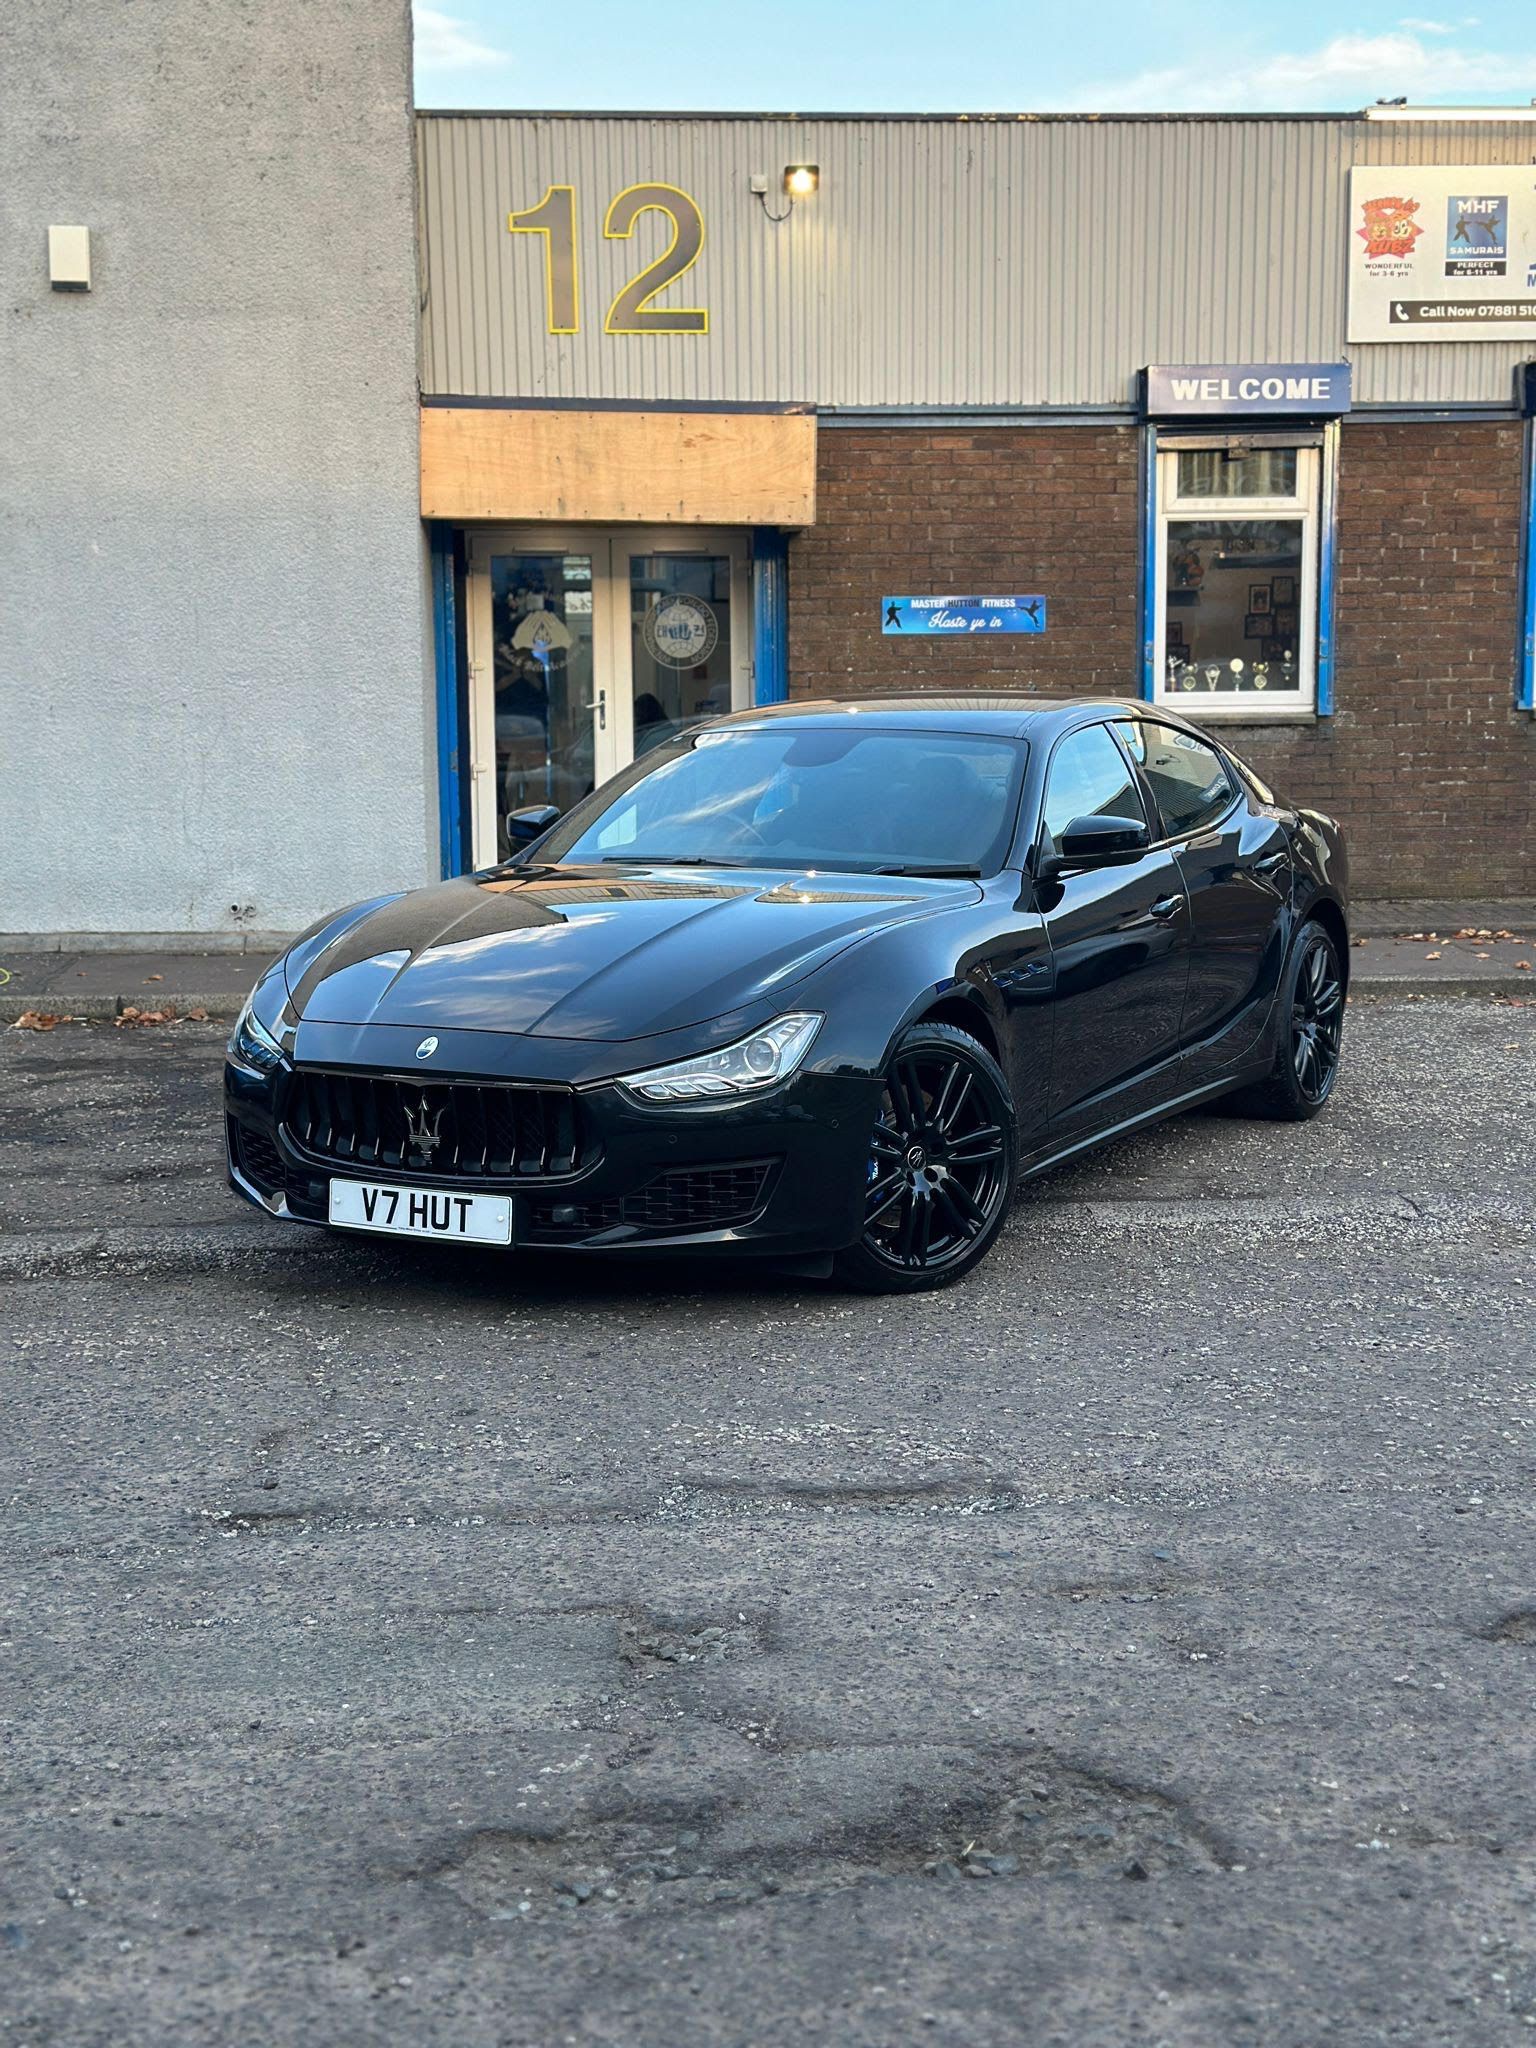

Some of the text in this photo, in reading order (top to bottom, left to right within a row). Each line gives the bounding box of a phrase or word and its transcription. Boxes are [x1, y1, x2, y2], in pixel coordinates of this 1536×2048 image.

[1457, 200, 1499, 214] MHF
[508, 183, 708, 334] 12
[1420, 305, 1445, 318] Call
[1447, 306, 1476, 317] Now
[1478, 305, 1517, 317] 07881
[1171, 378, 1331, 401] WELCOME
[911, 598, 1016, 609] MASTER HUTTON FITNESS
[928, 610, 1003, 631] Haste ye in
[362, 1187, 473, 1232] V7 HUT
